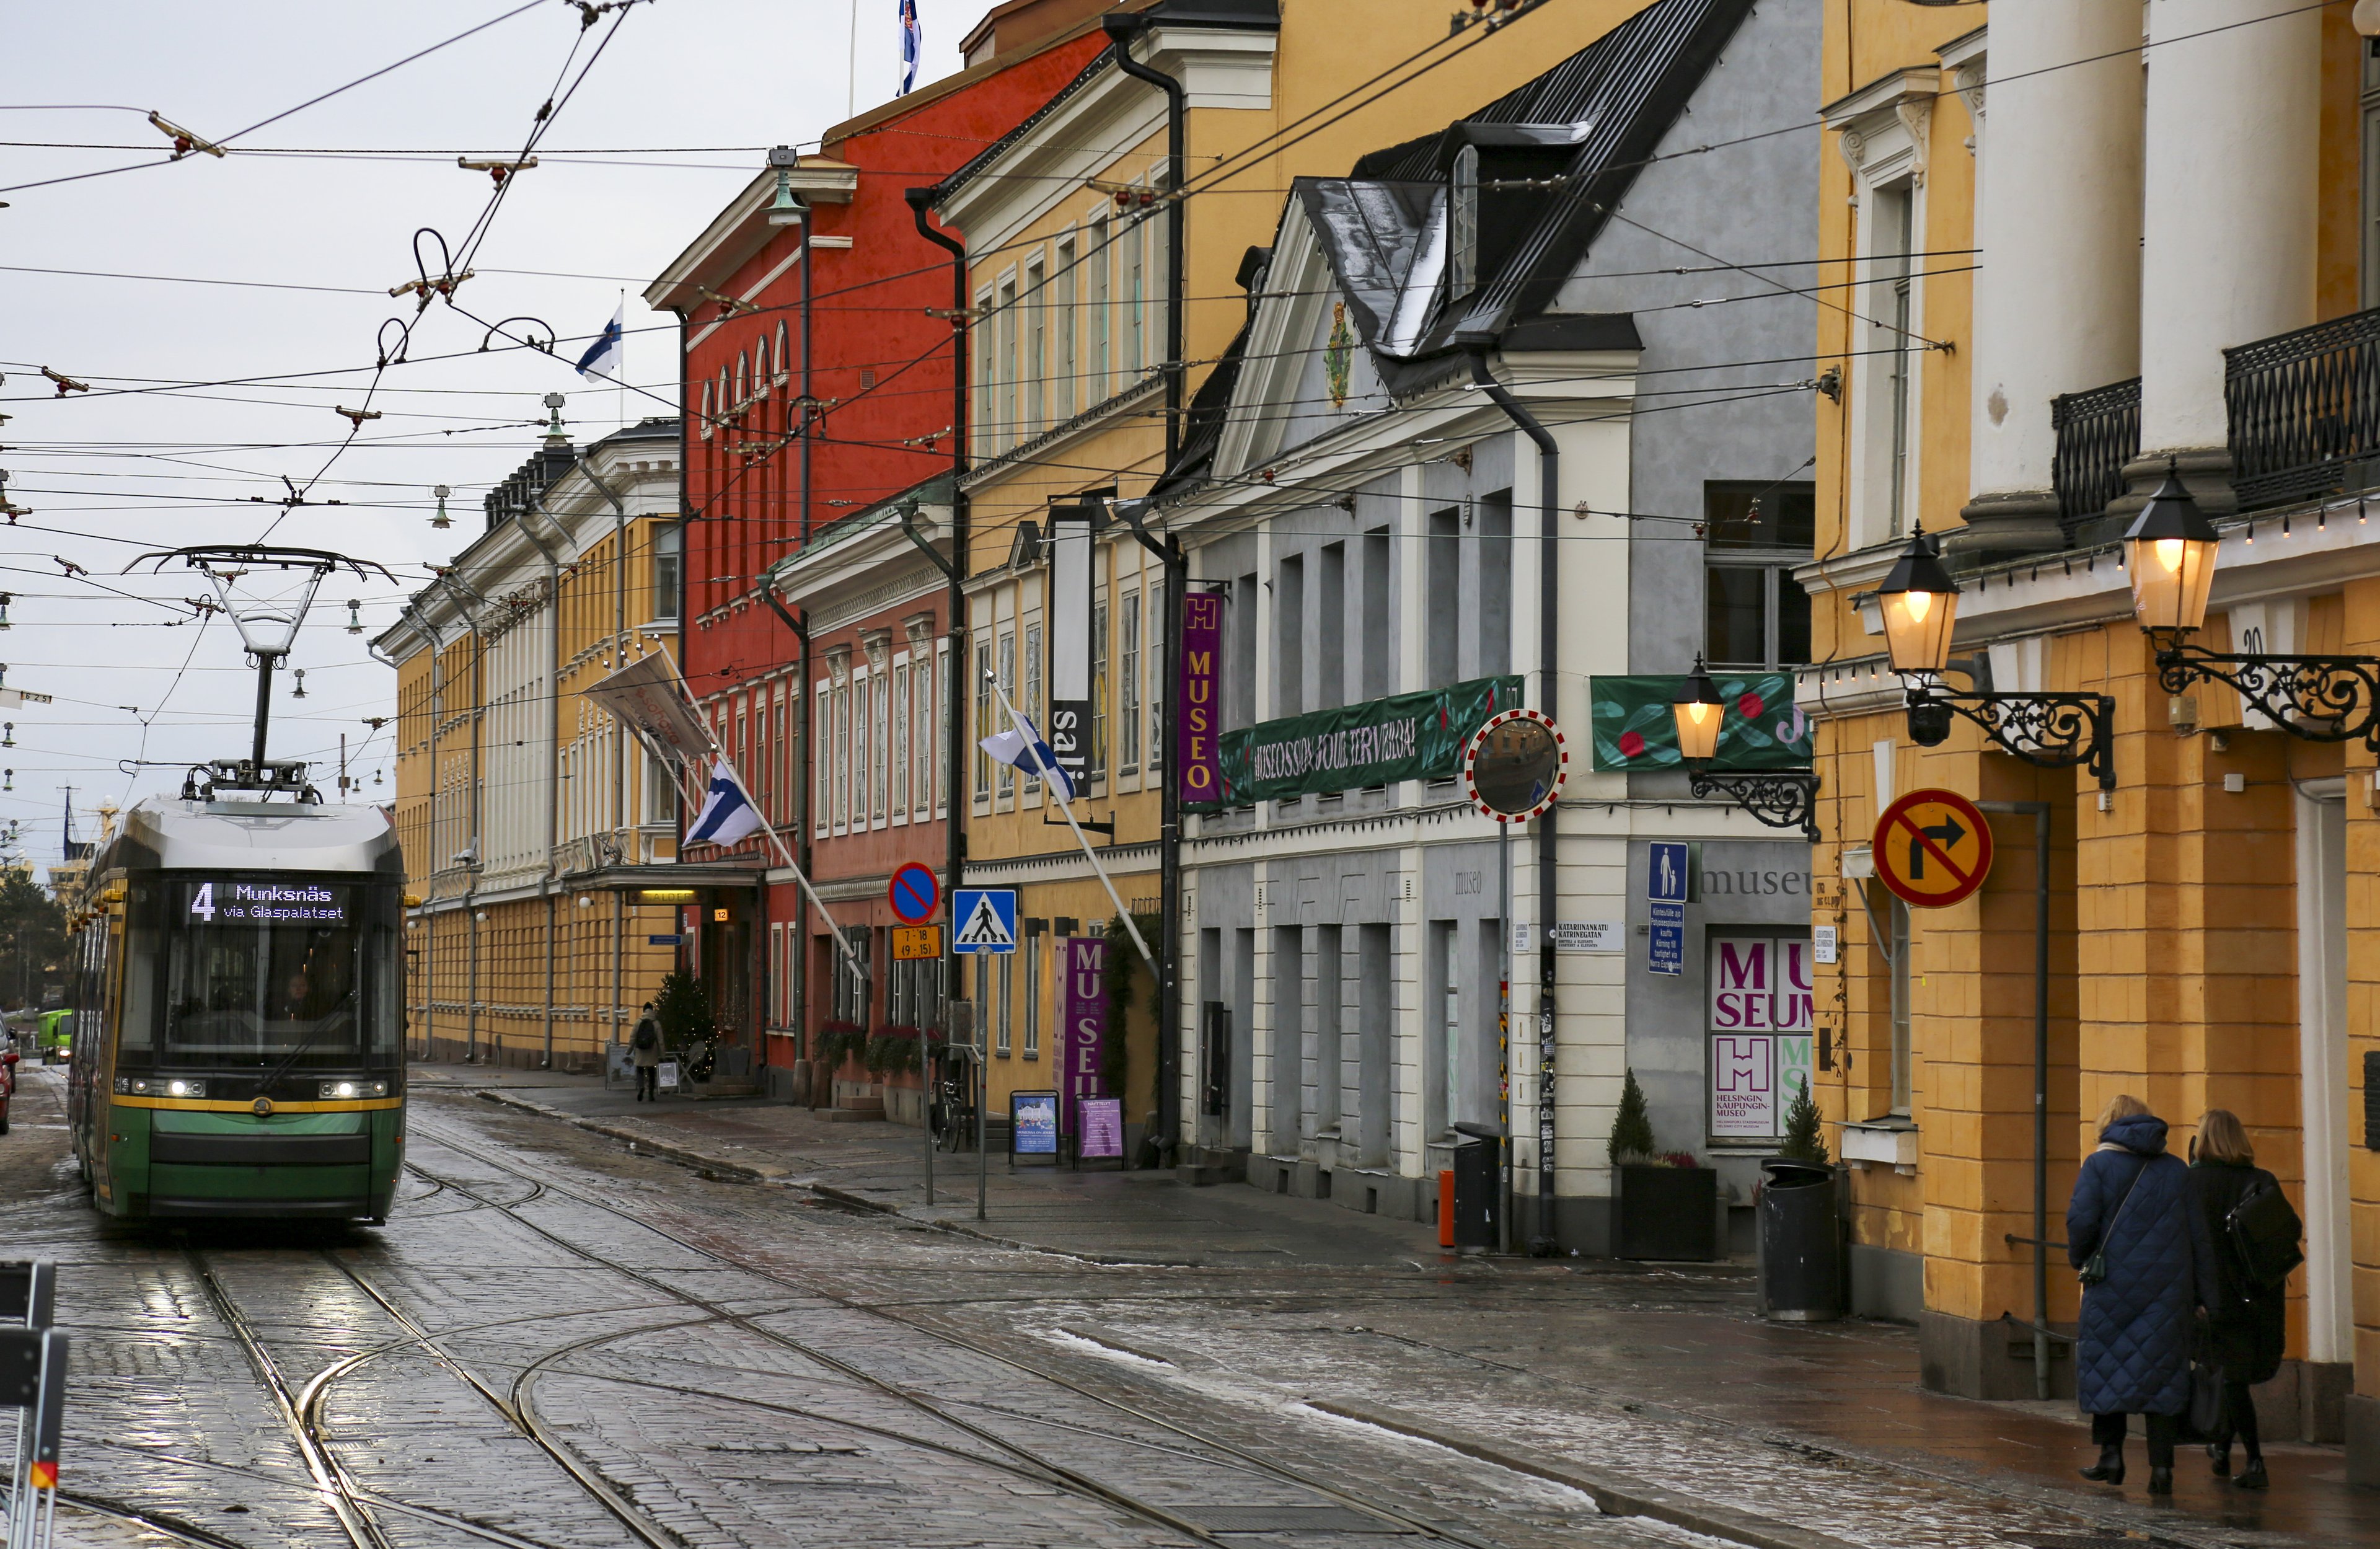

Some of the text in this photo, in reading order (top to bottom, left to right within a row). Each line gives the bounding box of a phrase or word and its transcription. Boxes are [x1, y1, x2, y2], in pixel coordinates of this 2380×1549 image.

[642, 697, 681, 744] sohova
[1187, 651, 1210, 788] MUSEO
[1455, 871, 1481, 895] museo
[192, 883, 332, 921] 4 Munksnäs
[224, 905, 343, 921] via Glaspalatset
[905, 931, 909, 942] 7
[919, 930, 927, 940] 18
[1660, 929, 1672, 937] kautta
[902, 945, 910, 956] (9
[920, 943, 931, 955] 15)
